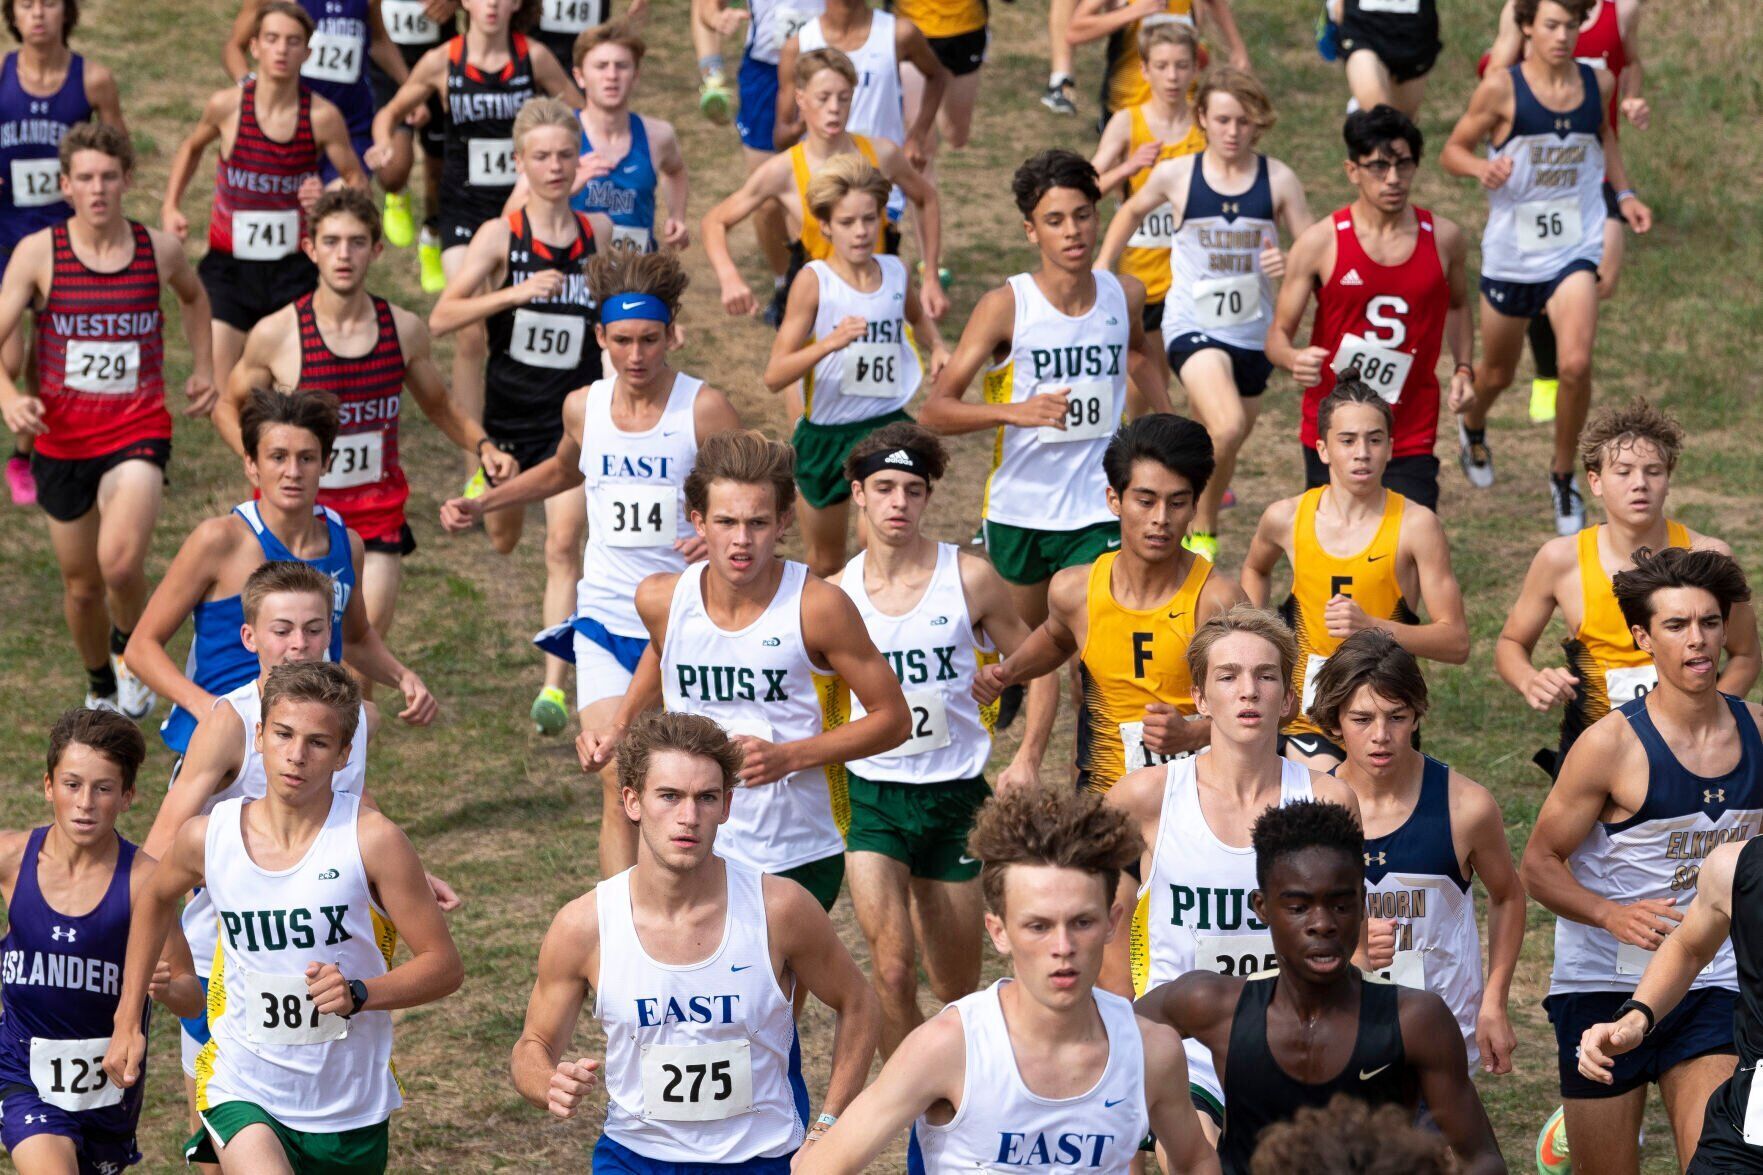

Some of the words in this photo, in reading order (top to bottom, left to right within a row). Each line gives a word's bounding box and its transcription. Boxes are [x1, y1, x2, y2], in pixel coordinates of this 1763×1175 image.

[554, 0, 590, 22] 148
[318, 46, 354, 69] 124
[227, 167, 306, 194] WESTSI
[585, 180, 638, 215] MN
[247, 223, 287, 247] 741
[1536, 212, 1563, 238] 56
[1213, 290, 1242, 316] 70
[1364, 295, 1409, 349] S
[525, 326, 570, 355] 150
[81, 354, 127, 381] 729
[1031, 345, 1102, 380] PIUS
[1106, 344, 1123, 376] X
[1349, 352, 1397, 385] 686
[337, 394, 400, 425] STSID
[1069, 397, 1100, 427] 98
[327, 445, 369, 474] 731
[601, 454, 673, 480] EAST
[613, 501, 662, 533] 314
[881, 648, 928, 685] US
[932, 645, 958, 681] X
[1132, 632, 1154, 679] F
[676, 664, 755, 702] PIUS
[762, 669, 789, 702] X
[1367, 888, 1426, 919] HORN
[220, 908, 316, 952] PIUS
[319, 904, 353, 947] X
[2, 950, 122, 996] ISLANDER
[634, 994, 740, 1028] EAST
[50, 1056, 108, 1094] 123
[661, 1060, 733, 1103] 275
[994, 1131, 1114, 1168] EAST
